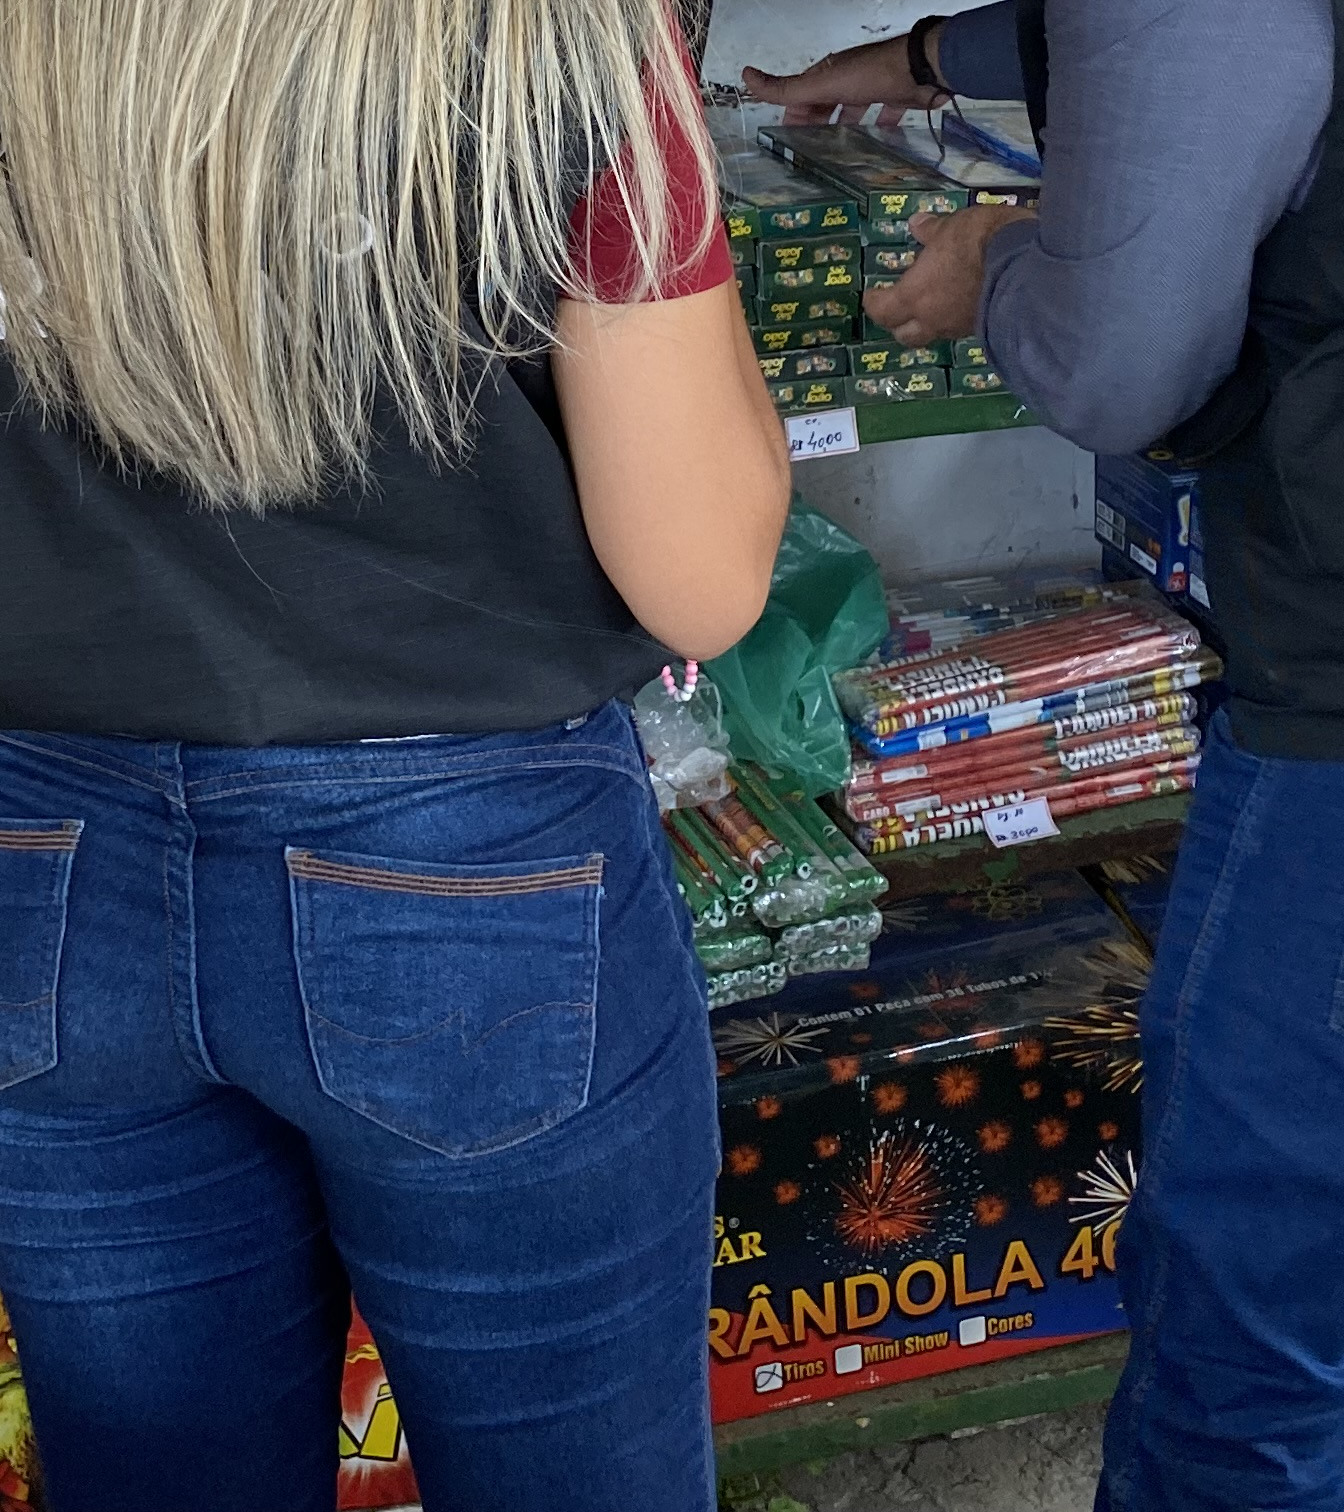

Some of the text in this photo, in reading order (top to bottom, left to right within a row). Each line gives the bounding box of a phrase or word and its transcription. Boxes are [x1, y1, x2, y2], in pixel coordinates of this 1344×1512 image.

[710, 1240, 1045, 1360] RÂNDOLA
[988, 1313, 1033, 1336] Cores
[864, 1330, 948, 1365] Mini Show
[783, 1358, 824, 1381] Tiros
